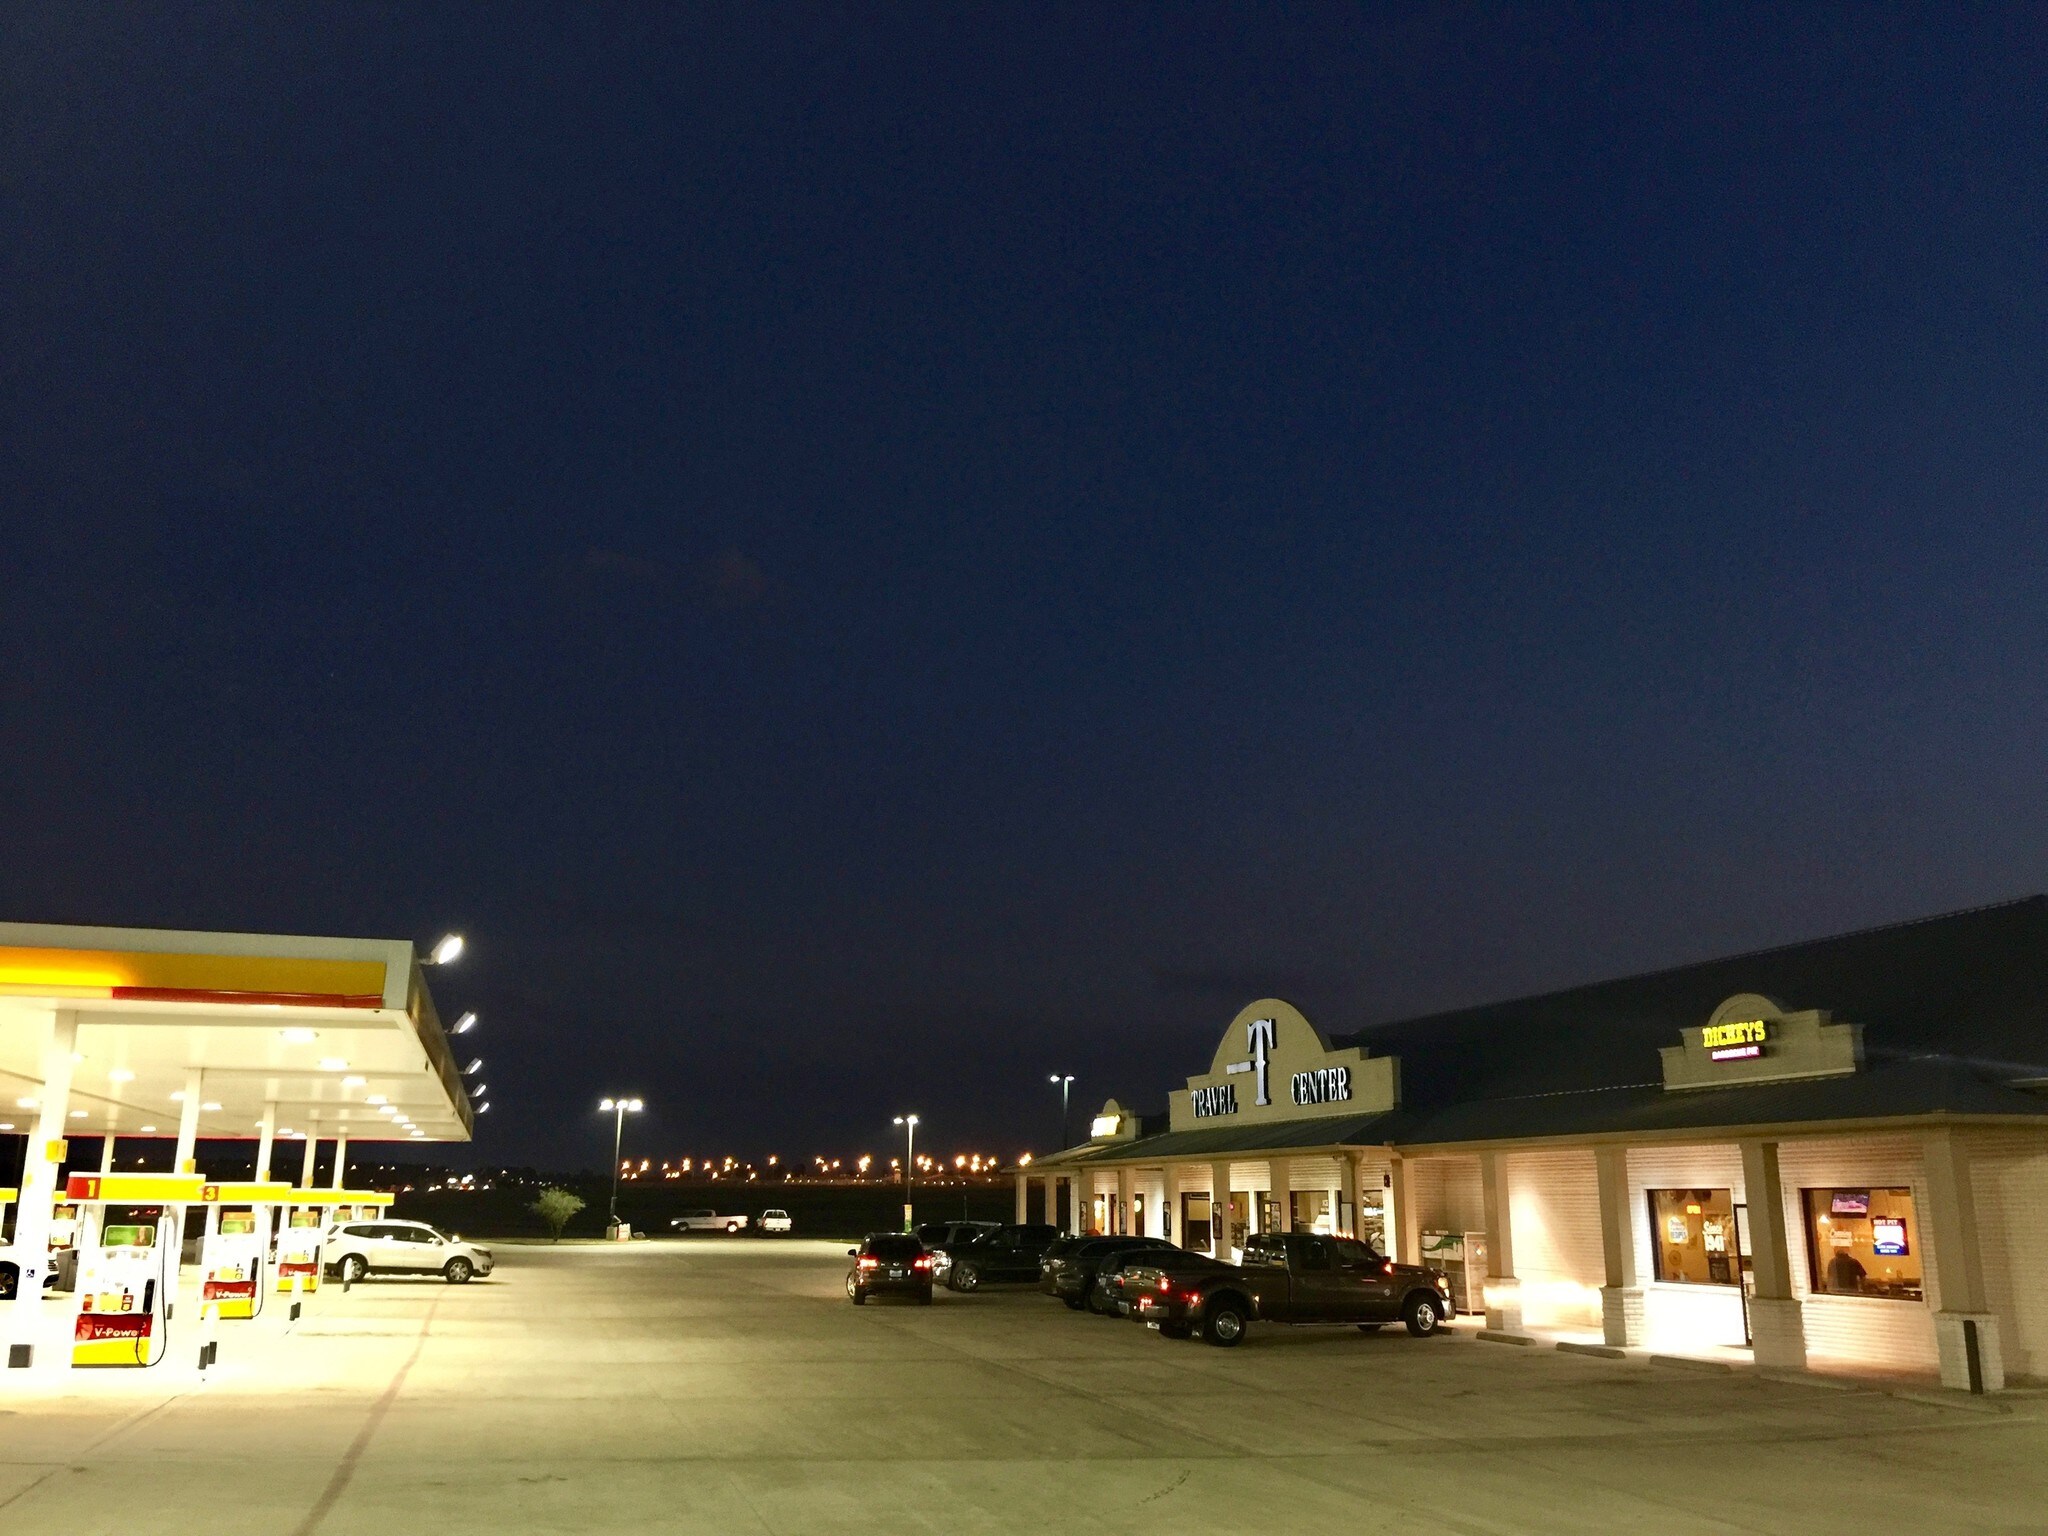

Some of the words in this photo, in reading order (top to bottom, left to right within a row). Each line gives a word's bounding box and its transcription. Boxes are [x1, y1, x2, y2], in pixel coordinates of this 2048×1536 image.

[1191, 1084, 1236, 1118] TRAVEL
[1290, 1066, 1348, 1106] CENTER
[87, 1179, 97, 1198] 1
[204, 1187, 216, 1201] 3
